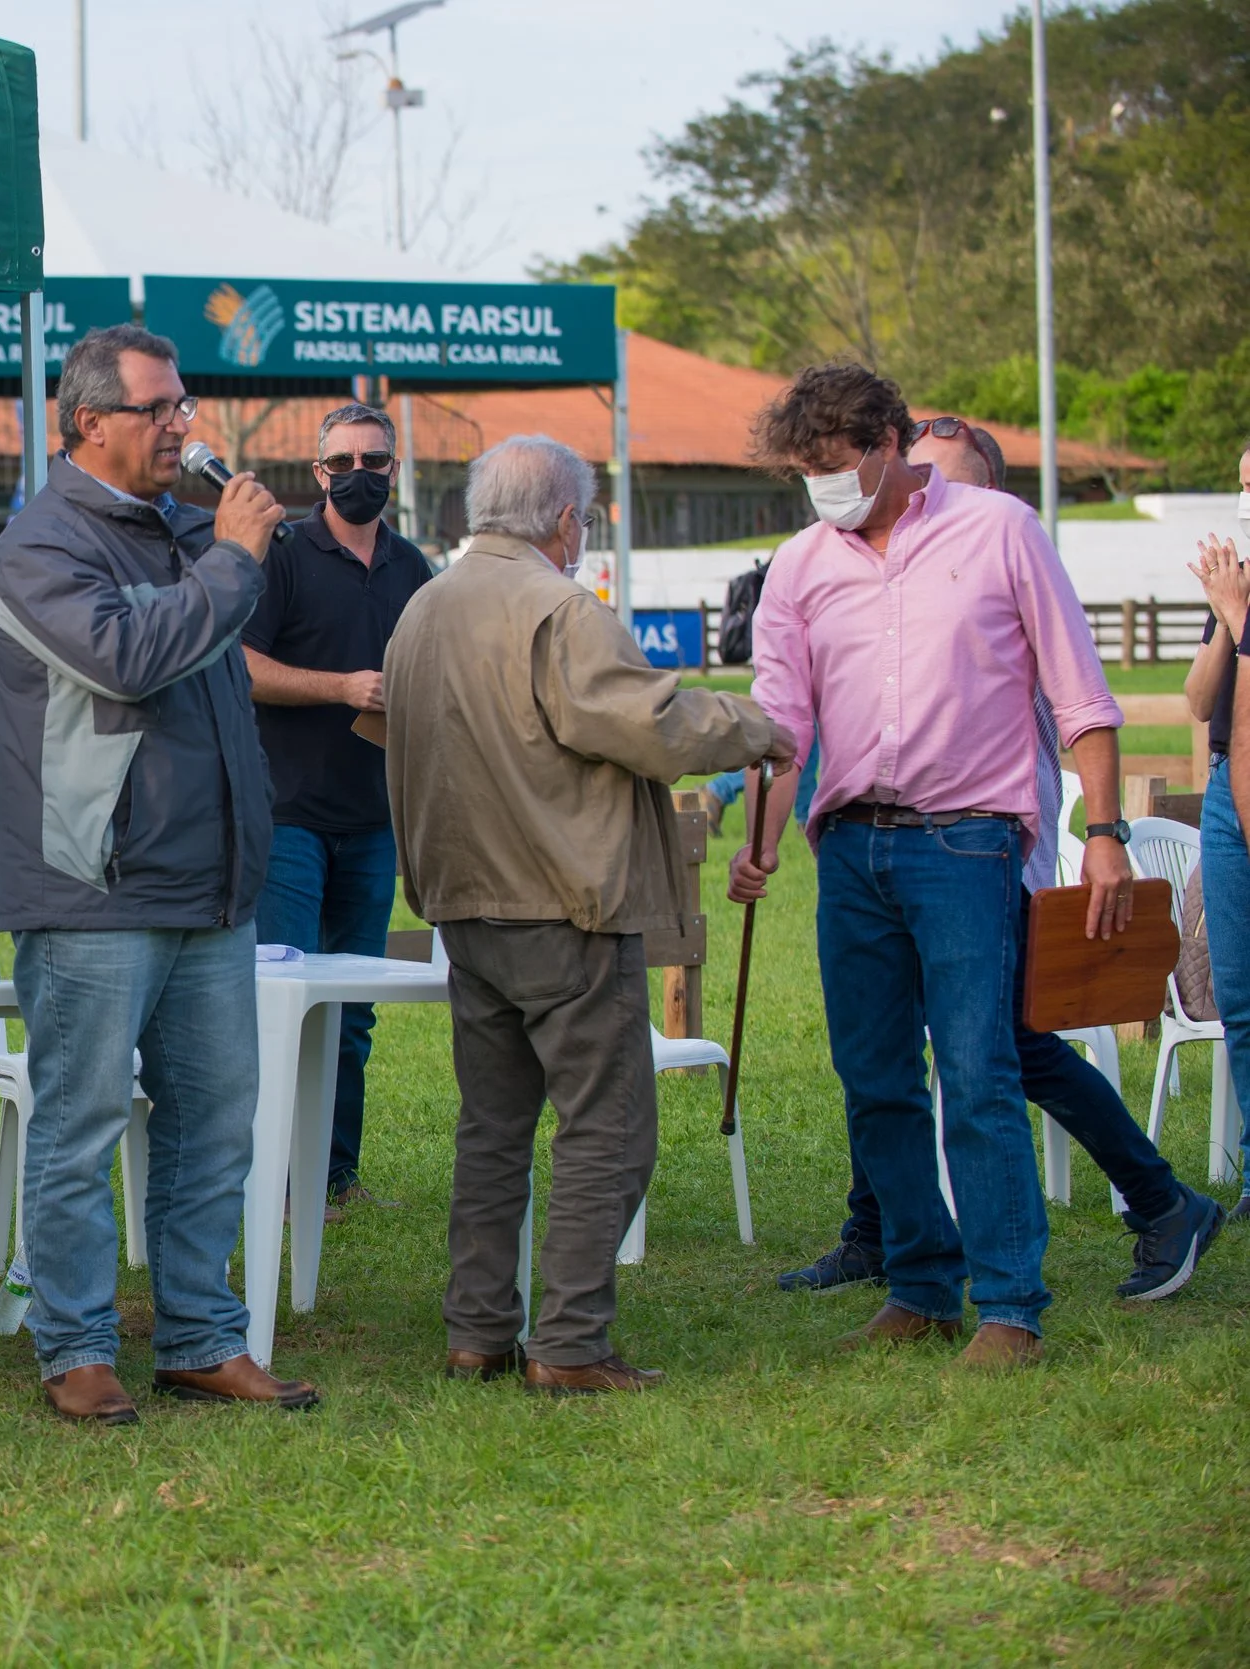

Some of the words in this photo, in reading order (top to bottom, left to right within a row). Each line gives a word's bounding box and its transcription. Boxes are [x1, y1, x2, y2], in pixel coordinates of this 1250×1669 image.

[294, 301, 435, 334] SISTEMA
[441, 304, 562, 337] FARSUL
[294, 340, 366, 362] FARSUL
[374, 341, 441, 364] SENAR
[447, 344, 499, 364] CASA
[500, 345, 563, 366] RURAL
